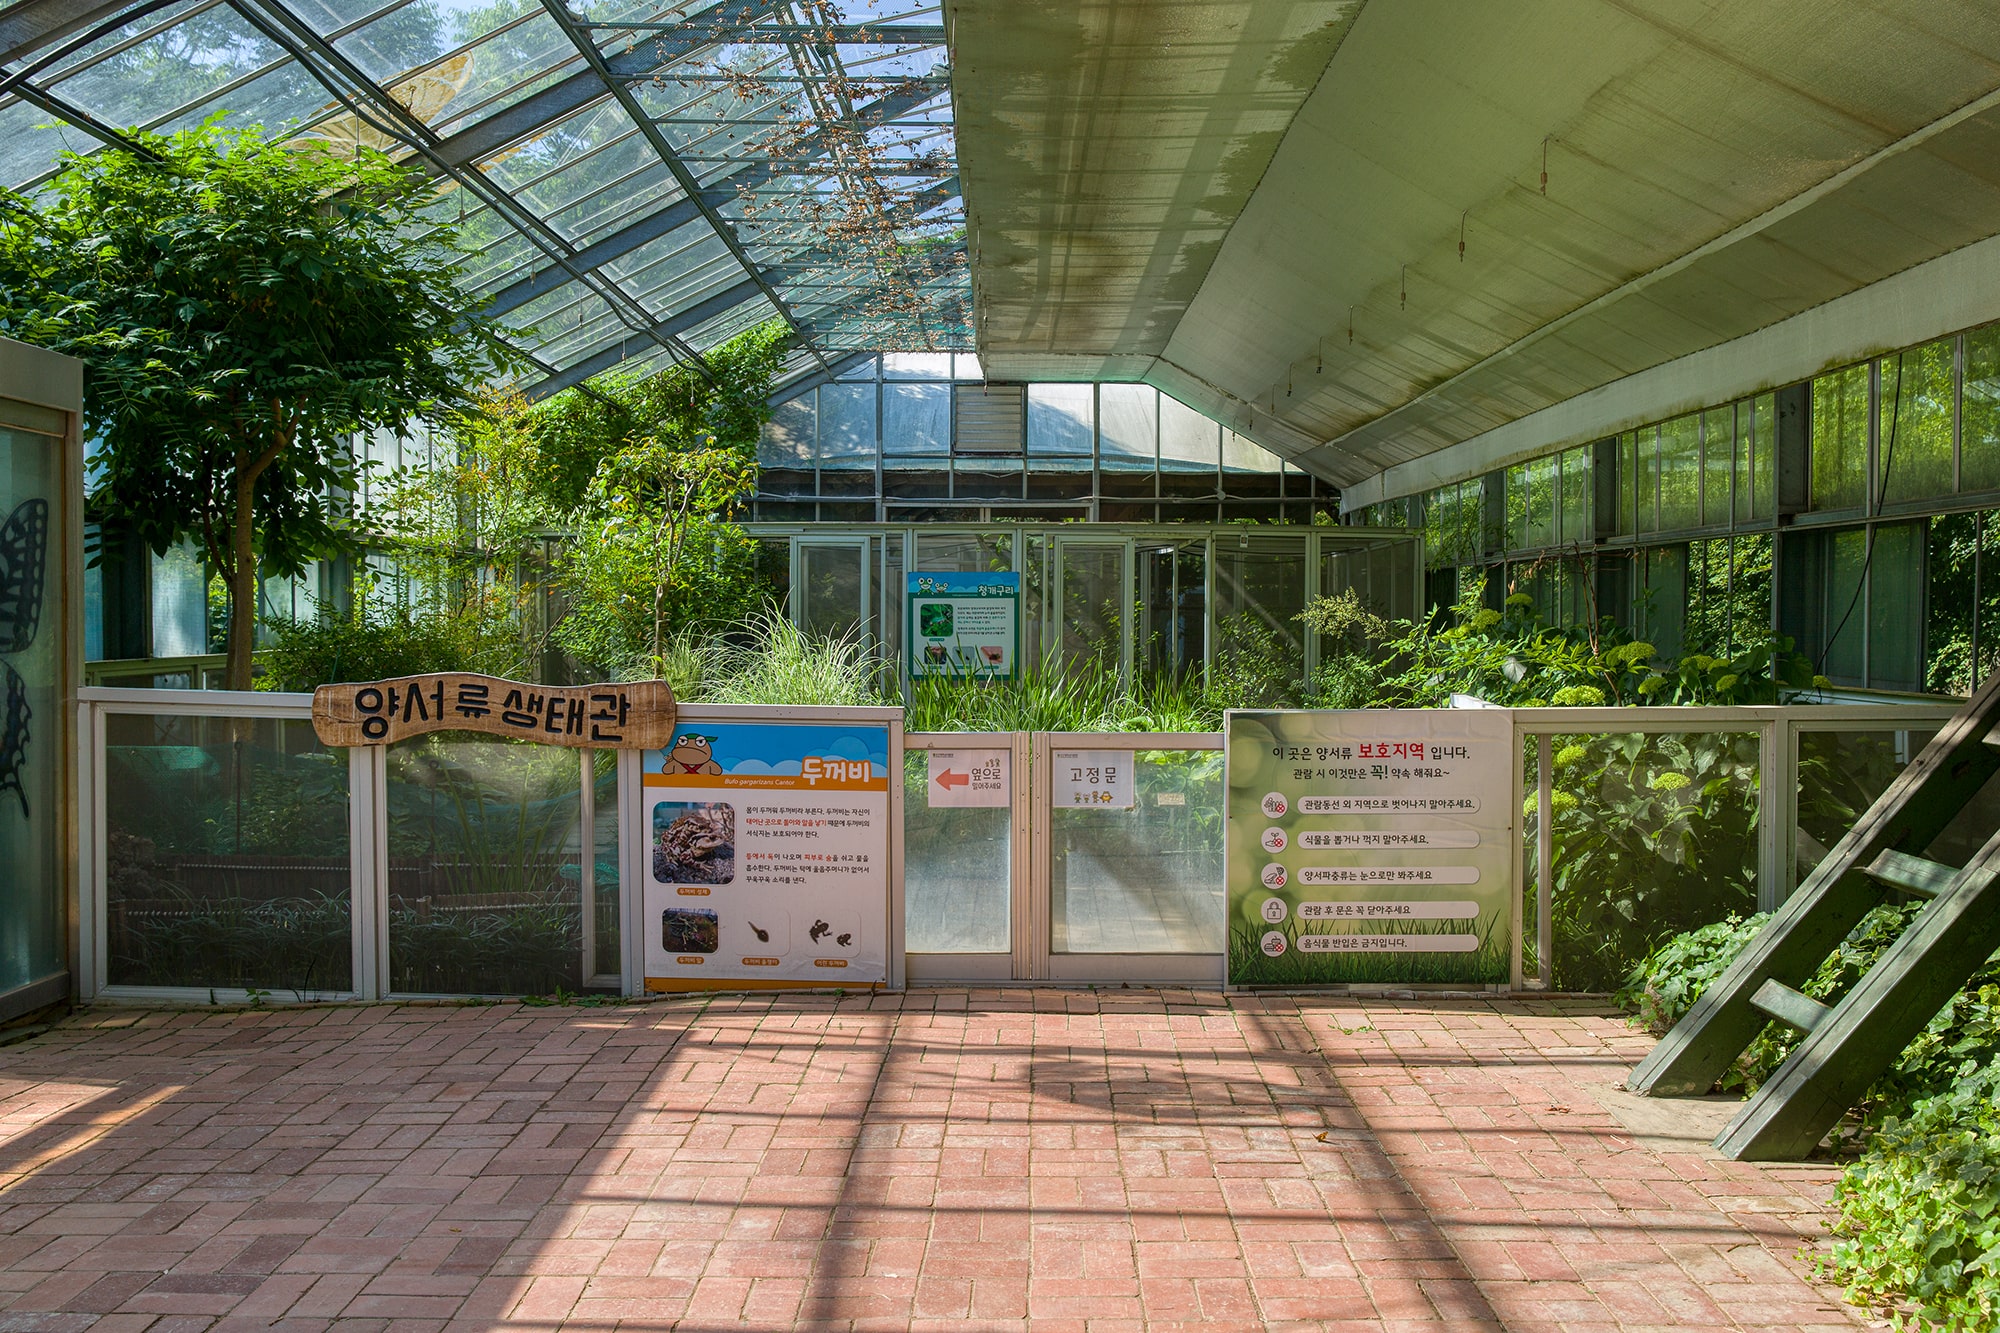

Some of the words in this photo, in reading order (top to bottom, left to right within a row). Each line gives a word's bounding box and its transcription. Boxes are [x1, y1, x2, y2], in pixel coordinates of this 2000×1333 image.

[978, 585, 1014, 596] 청개구리
[1273, 748, 1284, 759] 이
[1288, 748, 1312, 760] 곳은
[1316, 747, 1352, 760] 양서류
[1358, 743, 1424, 760] 보호지역
[1431, 747, 1470, 759] 입니다.
[801, 757, 871, 785] 두꺼비
[972, 768, 1001, 781] 옆으로
[1070, 767, 1116, 784] 고정문
[1293, 769, 1313, 779] 관람
[1316, 769, 1325, 778] 시
[1329, 769, 1367, 779] 이것만은
[1370, 765, 1388, 779] 꼭!
[1391, 768, 1410, 779] 약속
[1414, 768, 1450, 778] 해줘요~
[1305, 800, 1339, 809] 관람동선
[1343, 800, 1351, 809] 외
[1354, 800, 1389, 809] 지역으로
[1392, 800, 1426, 809] 벗어나지
[1430, 800, 1475, 809] 말아주세요.
[746, 806, 759, 814] 몸이
[779, 807, 804, 815] 두꺼비라
[851, 808, 871, 816] 자신이
[764, 818, 783, 826] 곳으로
[801, 819, 814, 827] 알을
[827, 819, 845, 827] 때문에
[746, 830, 771, 838] 서식지는
[772, 830, 804, 838] 보호되어야
[1305, 835, 1330, 845] 식물을
[1334, 835, 1360, 845] 뽑거나
[1383, 835, 1429, 845] 말아주세요.
[782, 853, 802, 861] 나오며
[840, 854, 854, 862] 쉬고
[772, 876, 791, 884] 소리를
[1305, 871, 1357, 881] 양서파충류는
[1360, 871, 1394, 880] 눈으로만
[1398, 871, 1432, 880] 봐주세요
[1304, 906, 1322, 915] 관람
[1325, 906, 1333, 914] 후
[1336, 906, 1353, 915] 문은
[1356, 906, 1364, 915] 꼭
[1368, 906, 1410, 915] 닫아주세요
[1304, 939, 1330, 948] 음식물
[1333, 939, 1358, 948] 반입은
[1362, 939, 1407, 948] 금지입니다.
